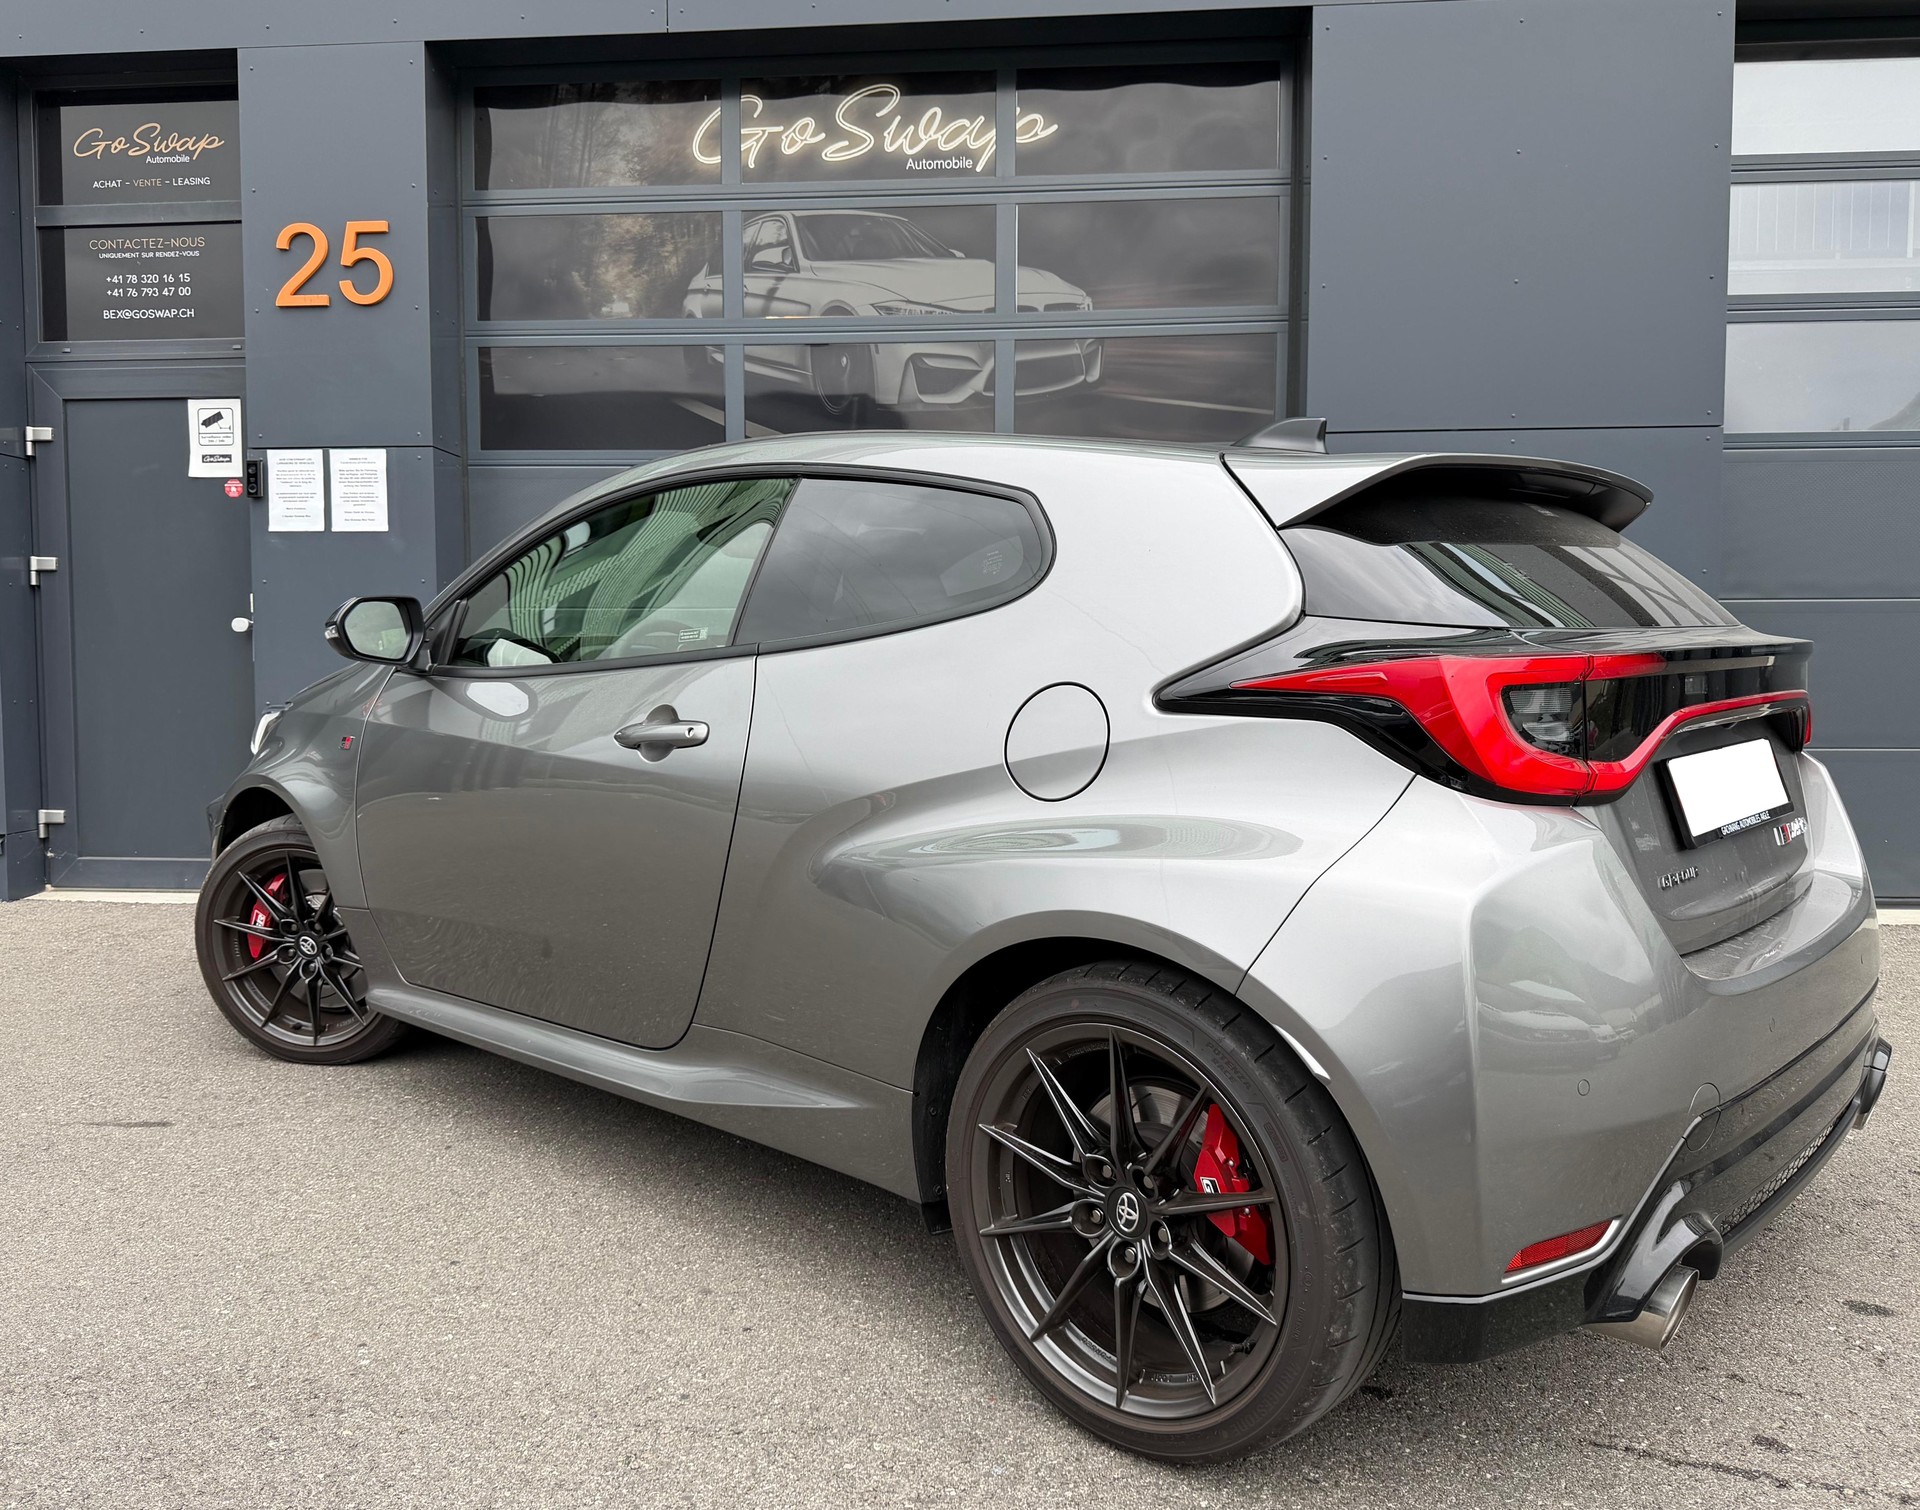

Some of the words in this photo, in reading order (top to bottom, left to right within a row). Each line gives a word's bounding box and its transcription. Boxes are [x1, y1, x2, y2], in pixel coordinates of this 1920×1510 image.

[693, 83, 1059, 172] GoSwap
[73, 122, 225, 160] GoSwap
[146, 154, 190, 164] Automobile
[906, 156, 973, 170] Automobile
[93, 179, 122, 189] ACHAT
[133, 178, 162, 187] VENTE
[173, 177, 211, 186] LEASING
[89, 236, 206, 250] CONTACTEZ-NOUS
[155, 250, 200, 258] RENDEZ-VOUS
[275, 220, 394, 307] 25
[106, 274, 123, 284] +41
[126, 274, 138, 284] 78
[141, 273, 159, 283] 320
[162, 273, 175, 282] 16
[178, 272, 191, 282] 15
[106, 288, 123, 298] +41
[126, 287, 138, 297] 76
[141, 287, 159, 297] 793
[162, 286, 175, 297] 47
[178, 286, 192, 296] 00
[103, 307, 195, 320] BEX@GOSWAP.CH
